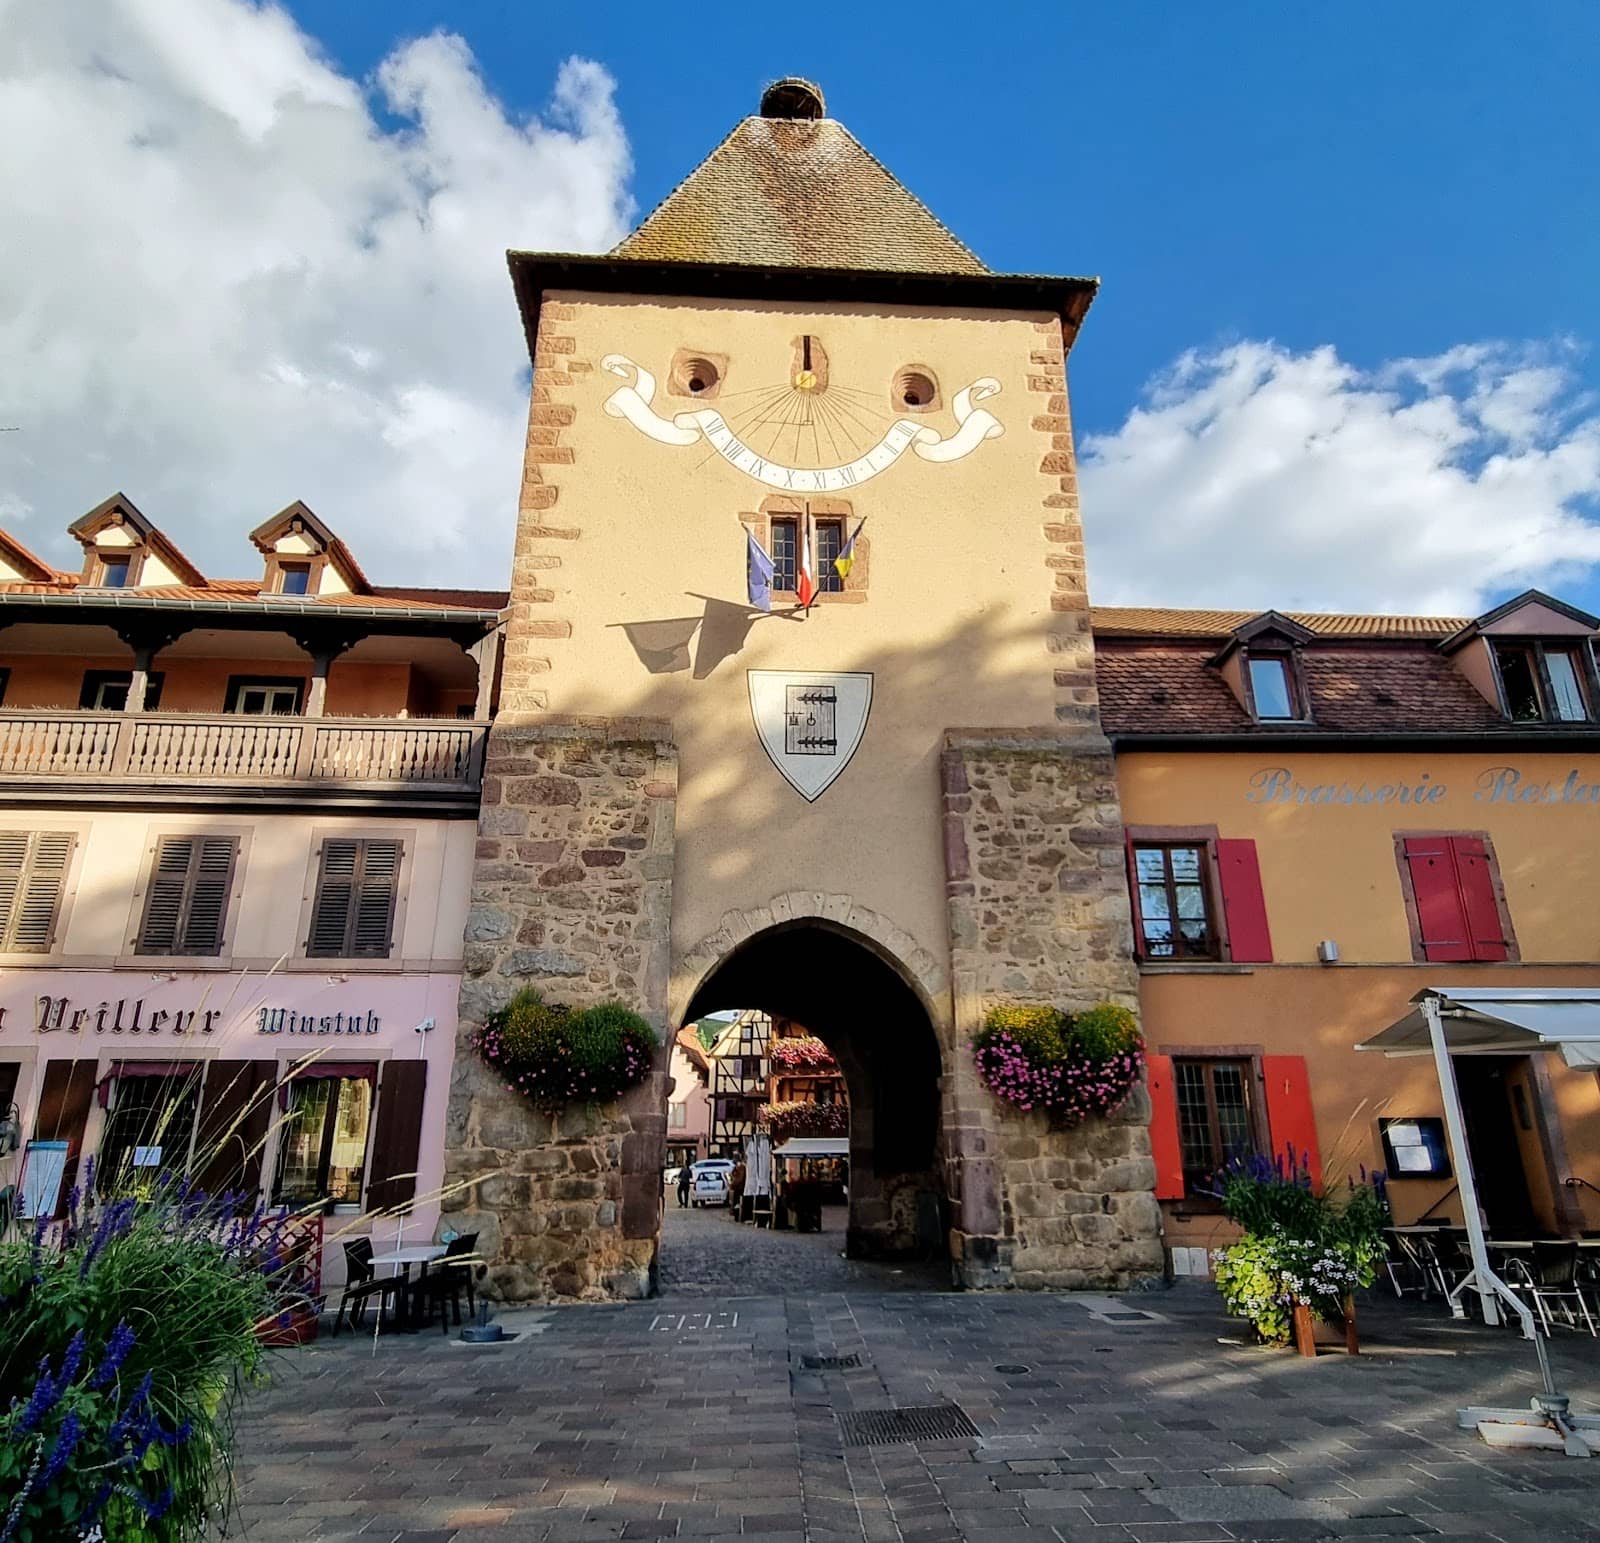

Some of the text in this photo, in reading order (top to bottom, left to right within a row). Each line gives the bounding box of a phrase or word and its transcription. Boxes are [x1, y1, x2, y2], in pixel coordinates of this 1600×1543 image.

[748, 458, 768, 477] IX
[783, 469, 796, 489] X
[812, 471, 827, 489] XI
[837, 465, 857, 486] XII
[1246, 767, 1447, 804] Brasserie
[256, 1007, 380, 1034] Winstub
